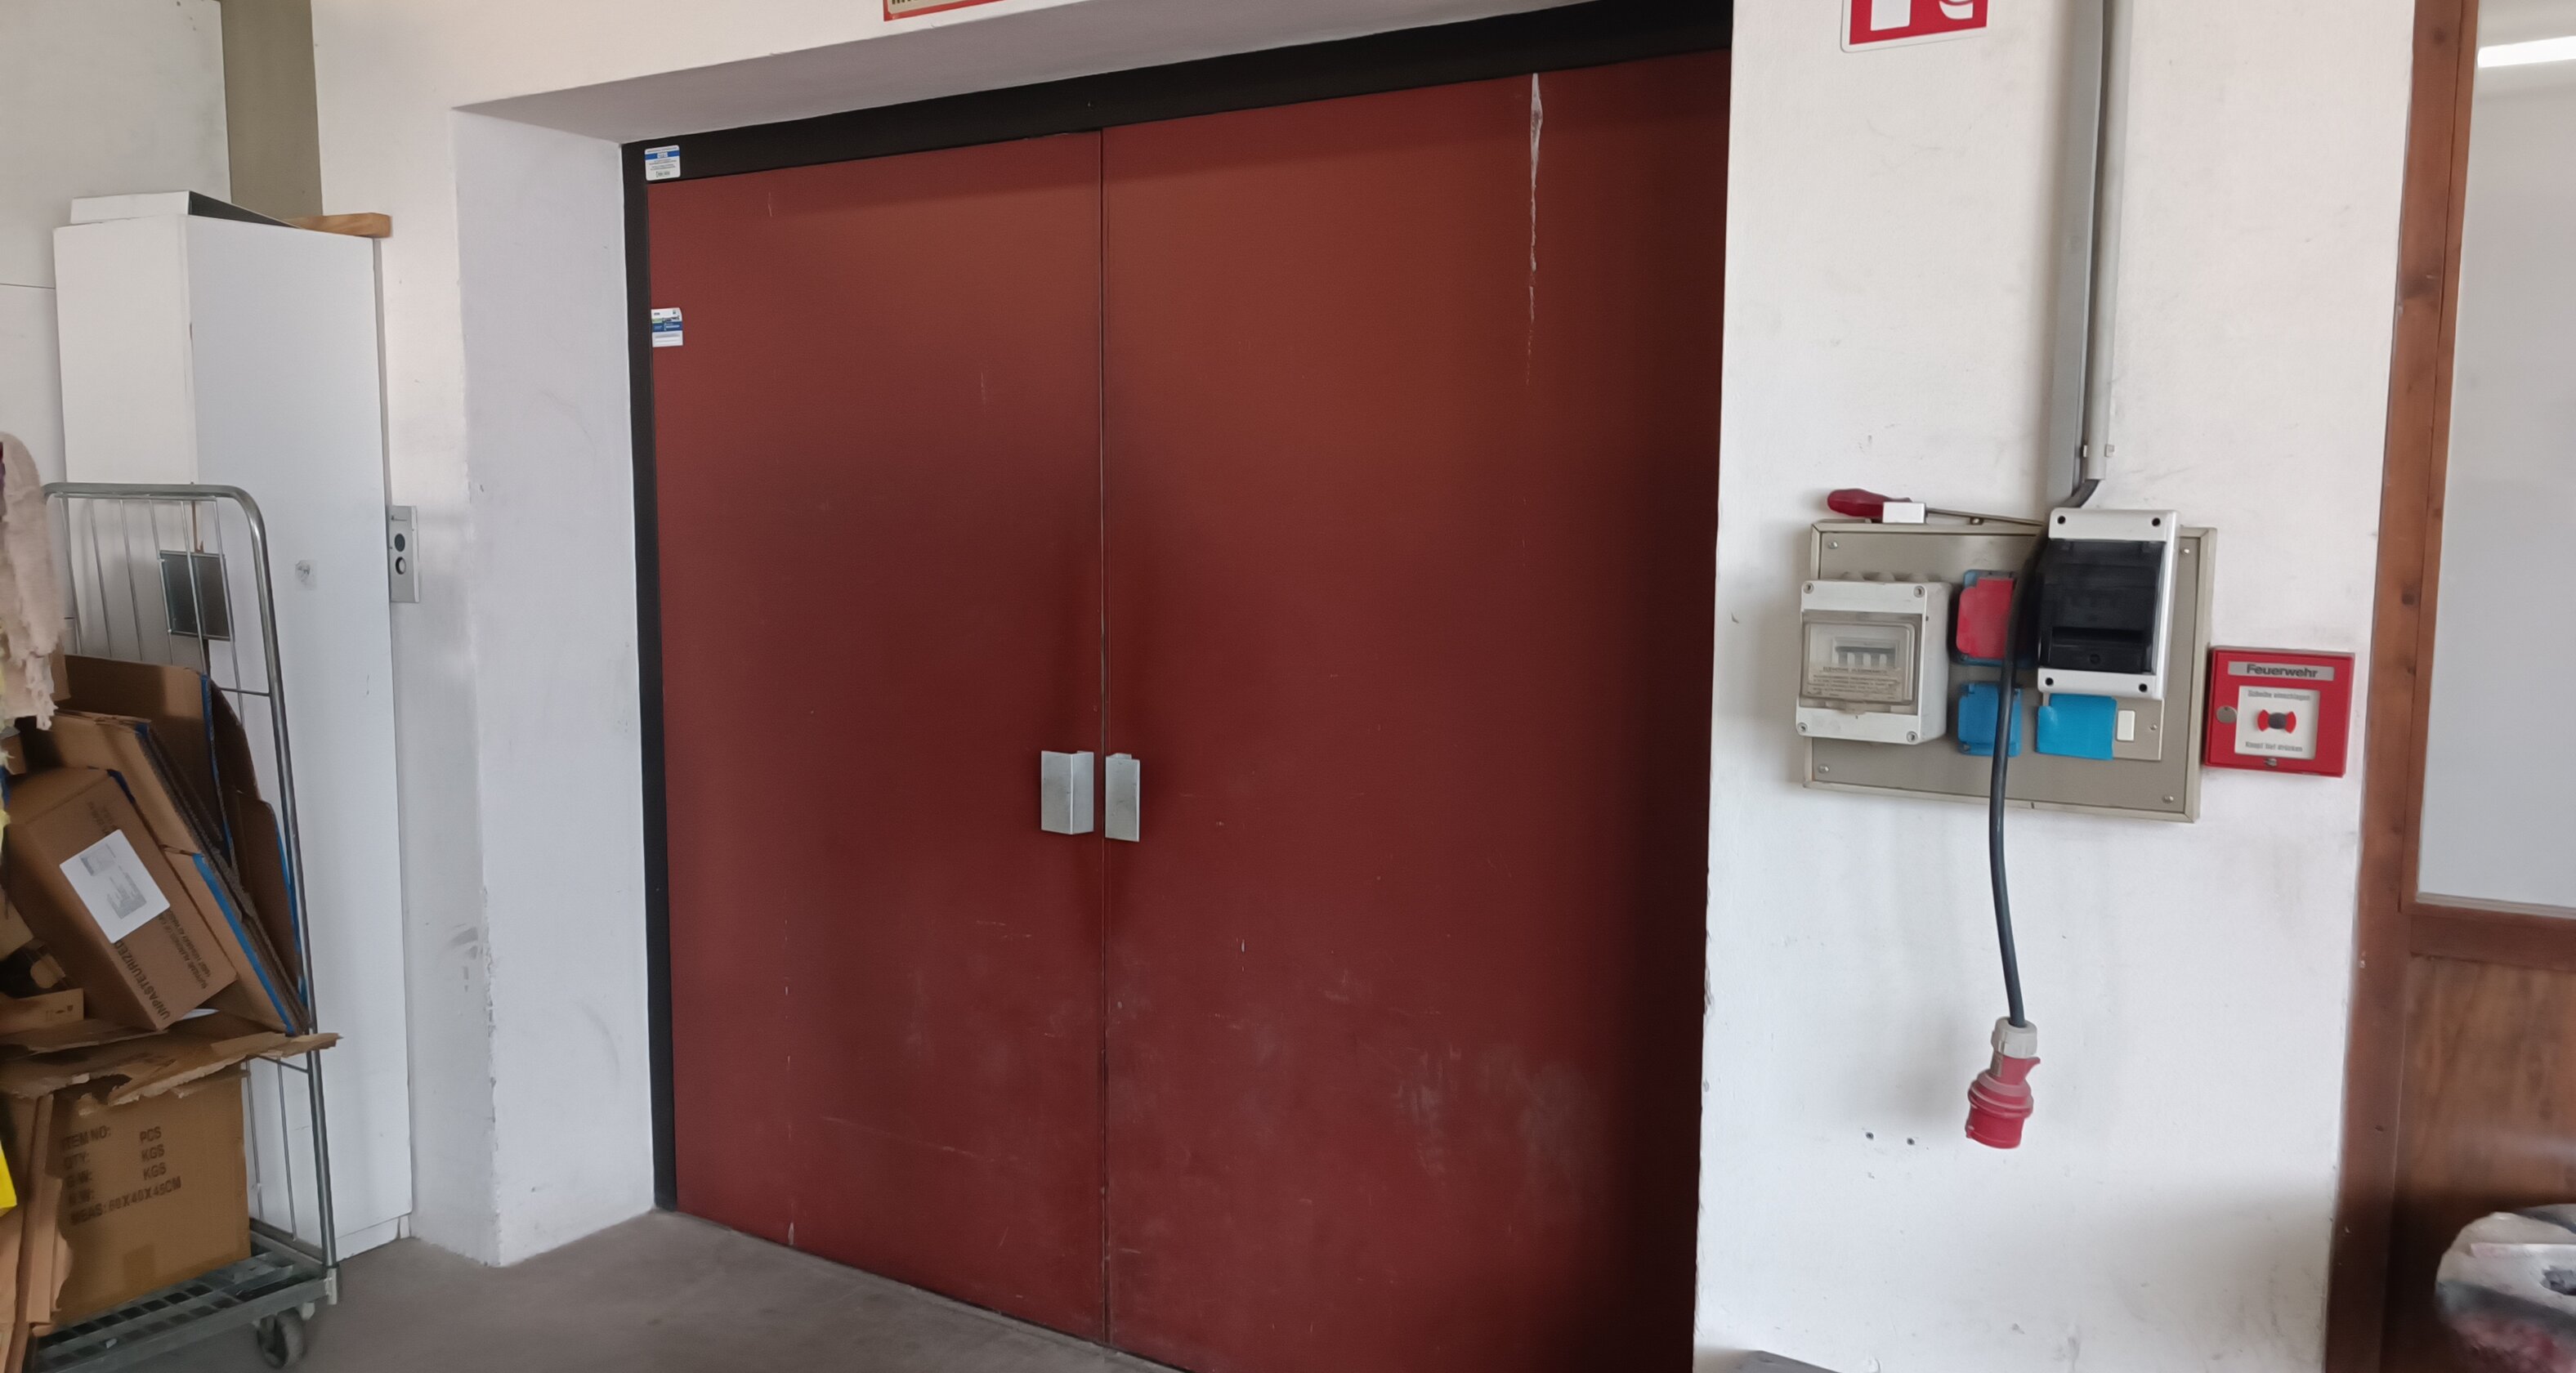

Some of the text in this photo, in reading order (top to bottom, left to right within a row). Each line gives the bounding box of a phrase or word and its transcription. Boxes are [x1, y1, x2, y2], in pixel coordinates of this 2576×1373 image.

[2246, 663, 2319, 678] Feuerwehr
[113, 939, 171, 1021] UNPASTEURIZED
[139, 1126, 162, 1143] PCS
[141, 1144, 165, 1162] KGS
[143, 1162, 167, 1180] KGS
